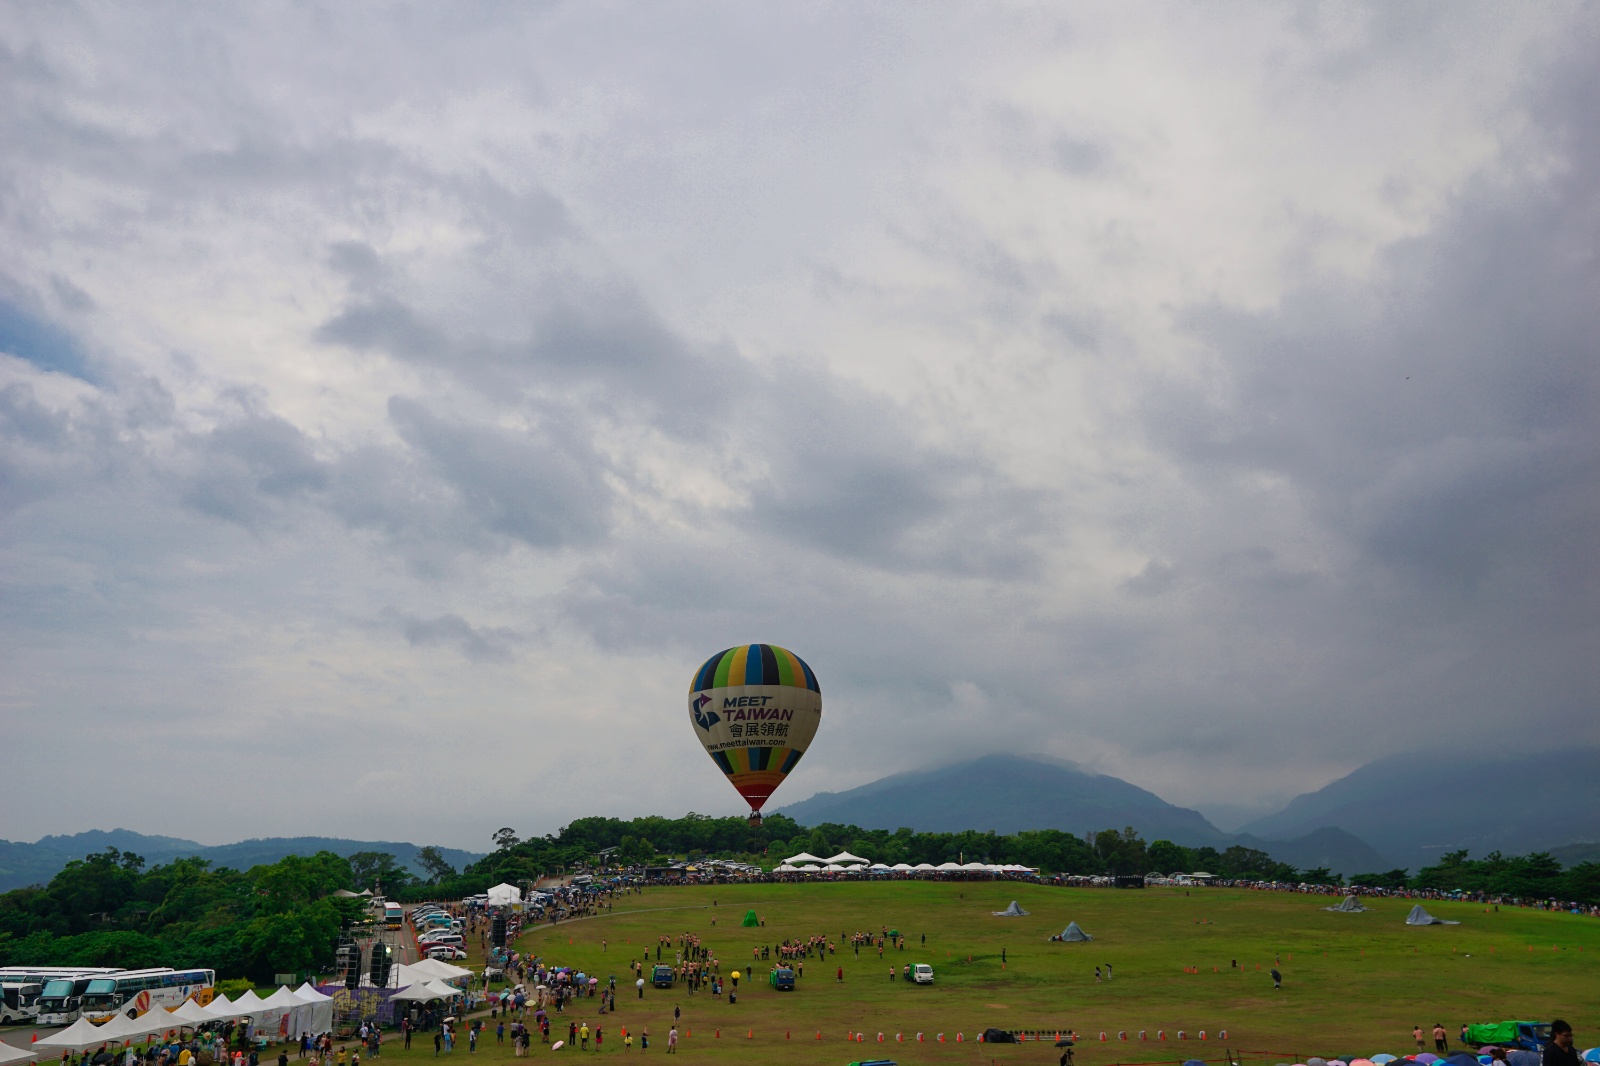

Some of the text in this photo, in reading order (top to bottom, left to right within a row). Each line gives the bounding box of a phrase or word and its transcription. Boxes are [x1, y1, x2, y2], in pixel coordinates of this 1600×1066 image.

[723, 696, 774, 708] MEET
[723, 708, 794, 721] TAIWAN
[729, 722, 789, 737] 會展領航
